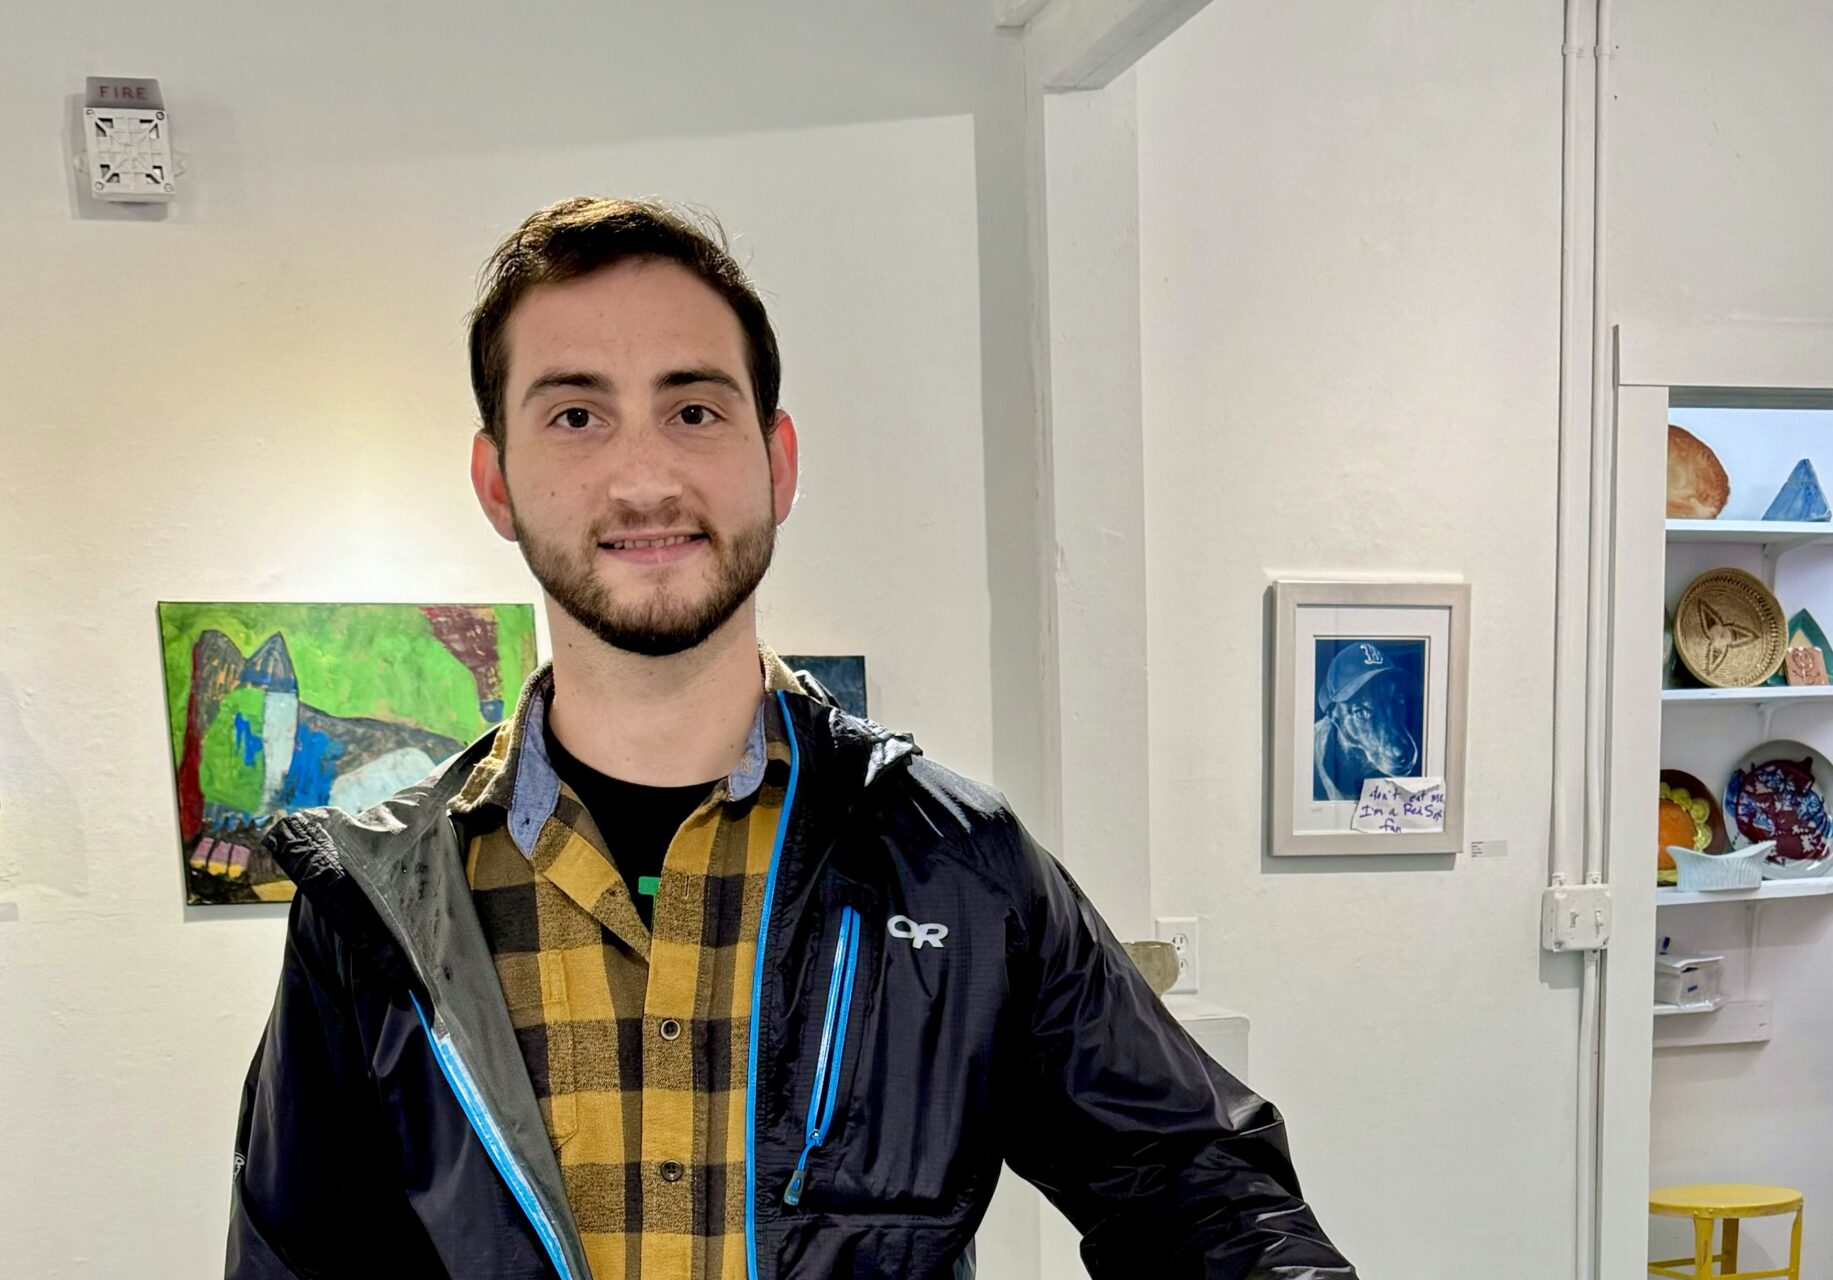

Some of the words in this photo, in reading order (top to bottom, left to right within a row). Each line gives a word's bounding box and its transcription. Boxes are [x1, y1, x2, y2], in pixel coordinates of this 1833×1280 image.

[99, 85, 147, 100] FIRE
[1369, 786, 1401, 801] don't
[1409, 789, 1426, 802] eat
[1359, 805, 1383, 818] I'm
[1389, 807, 1399, 817] a
[1403, 803, 1423, 816] Red
[1379, 818, 1402, 833] fan
[887, 915, 949, 949] OR
